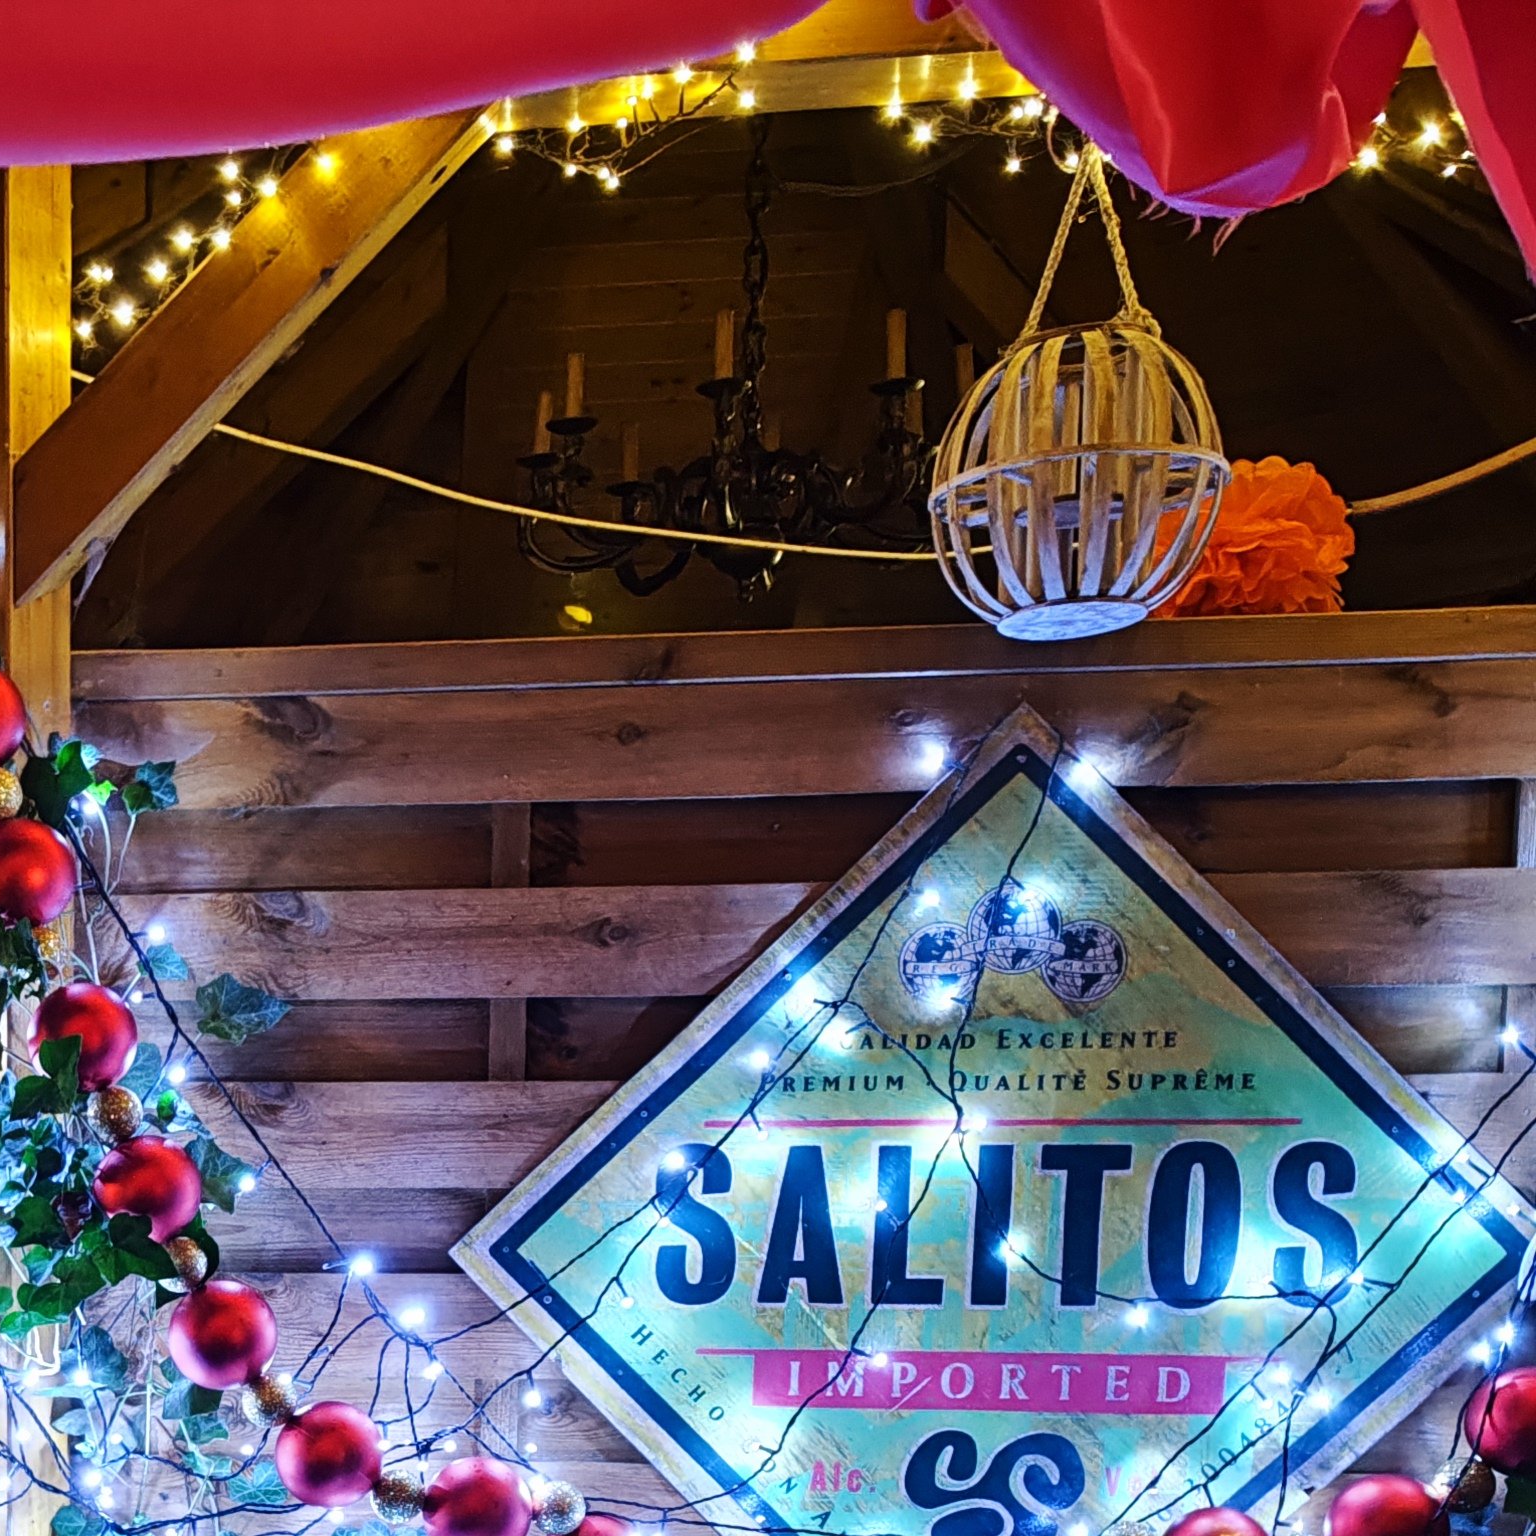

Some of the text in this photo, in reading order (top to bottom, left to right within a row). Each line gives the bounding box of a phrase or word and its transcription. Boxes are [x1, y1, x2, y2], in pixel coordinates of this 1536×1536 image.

[1065, 961, 1114, 975] MARK
[998, 1028, 1178, 1050] EXCELENTE
[1106, 1069, 1256, 1091] SUPRÊME
[651, 1138, 1362, 1311] SALITOS
[629, 1323, 726, 1422] HECHO
[787, 1360, 1192, 1404] IMPORTED
[809, 1459, 876, 1495] Alc.
